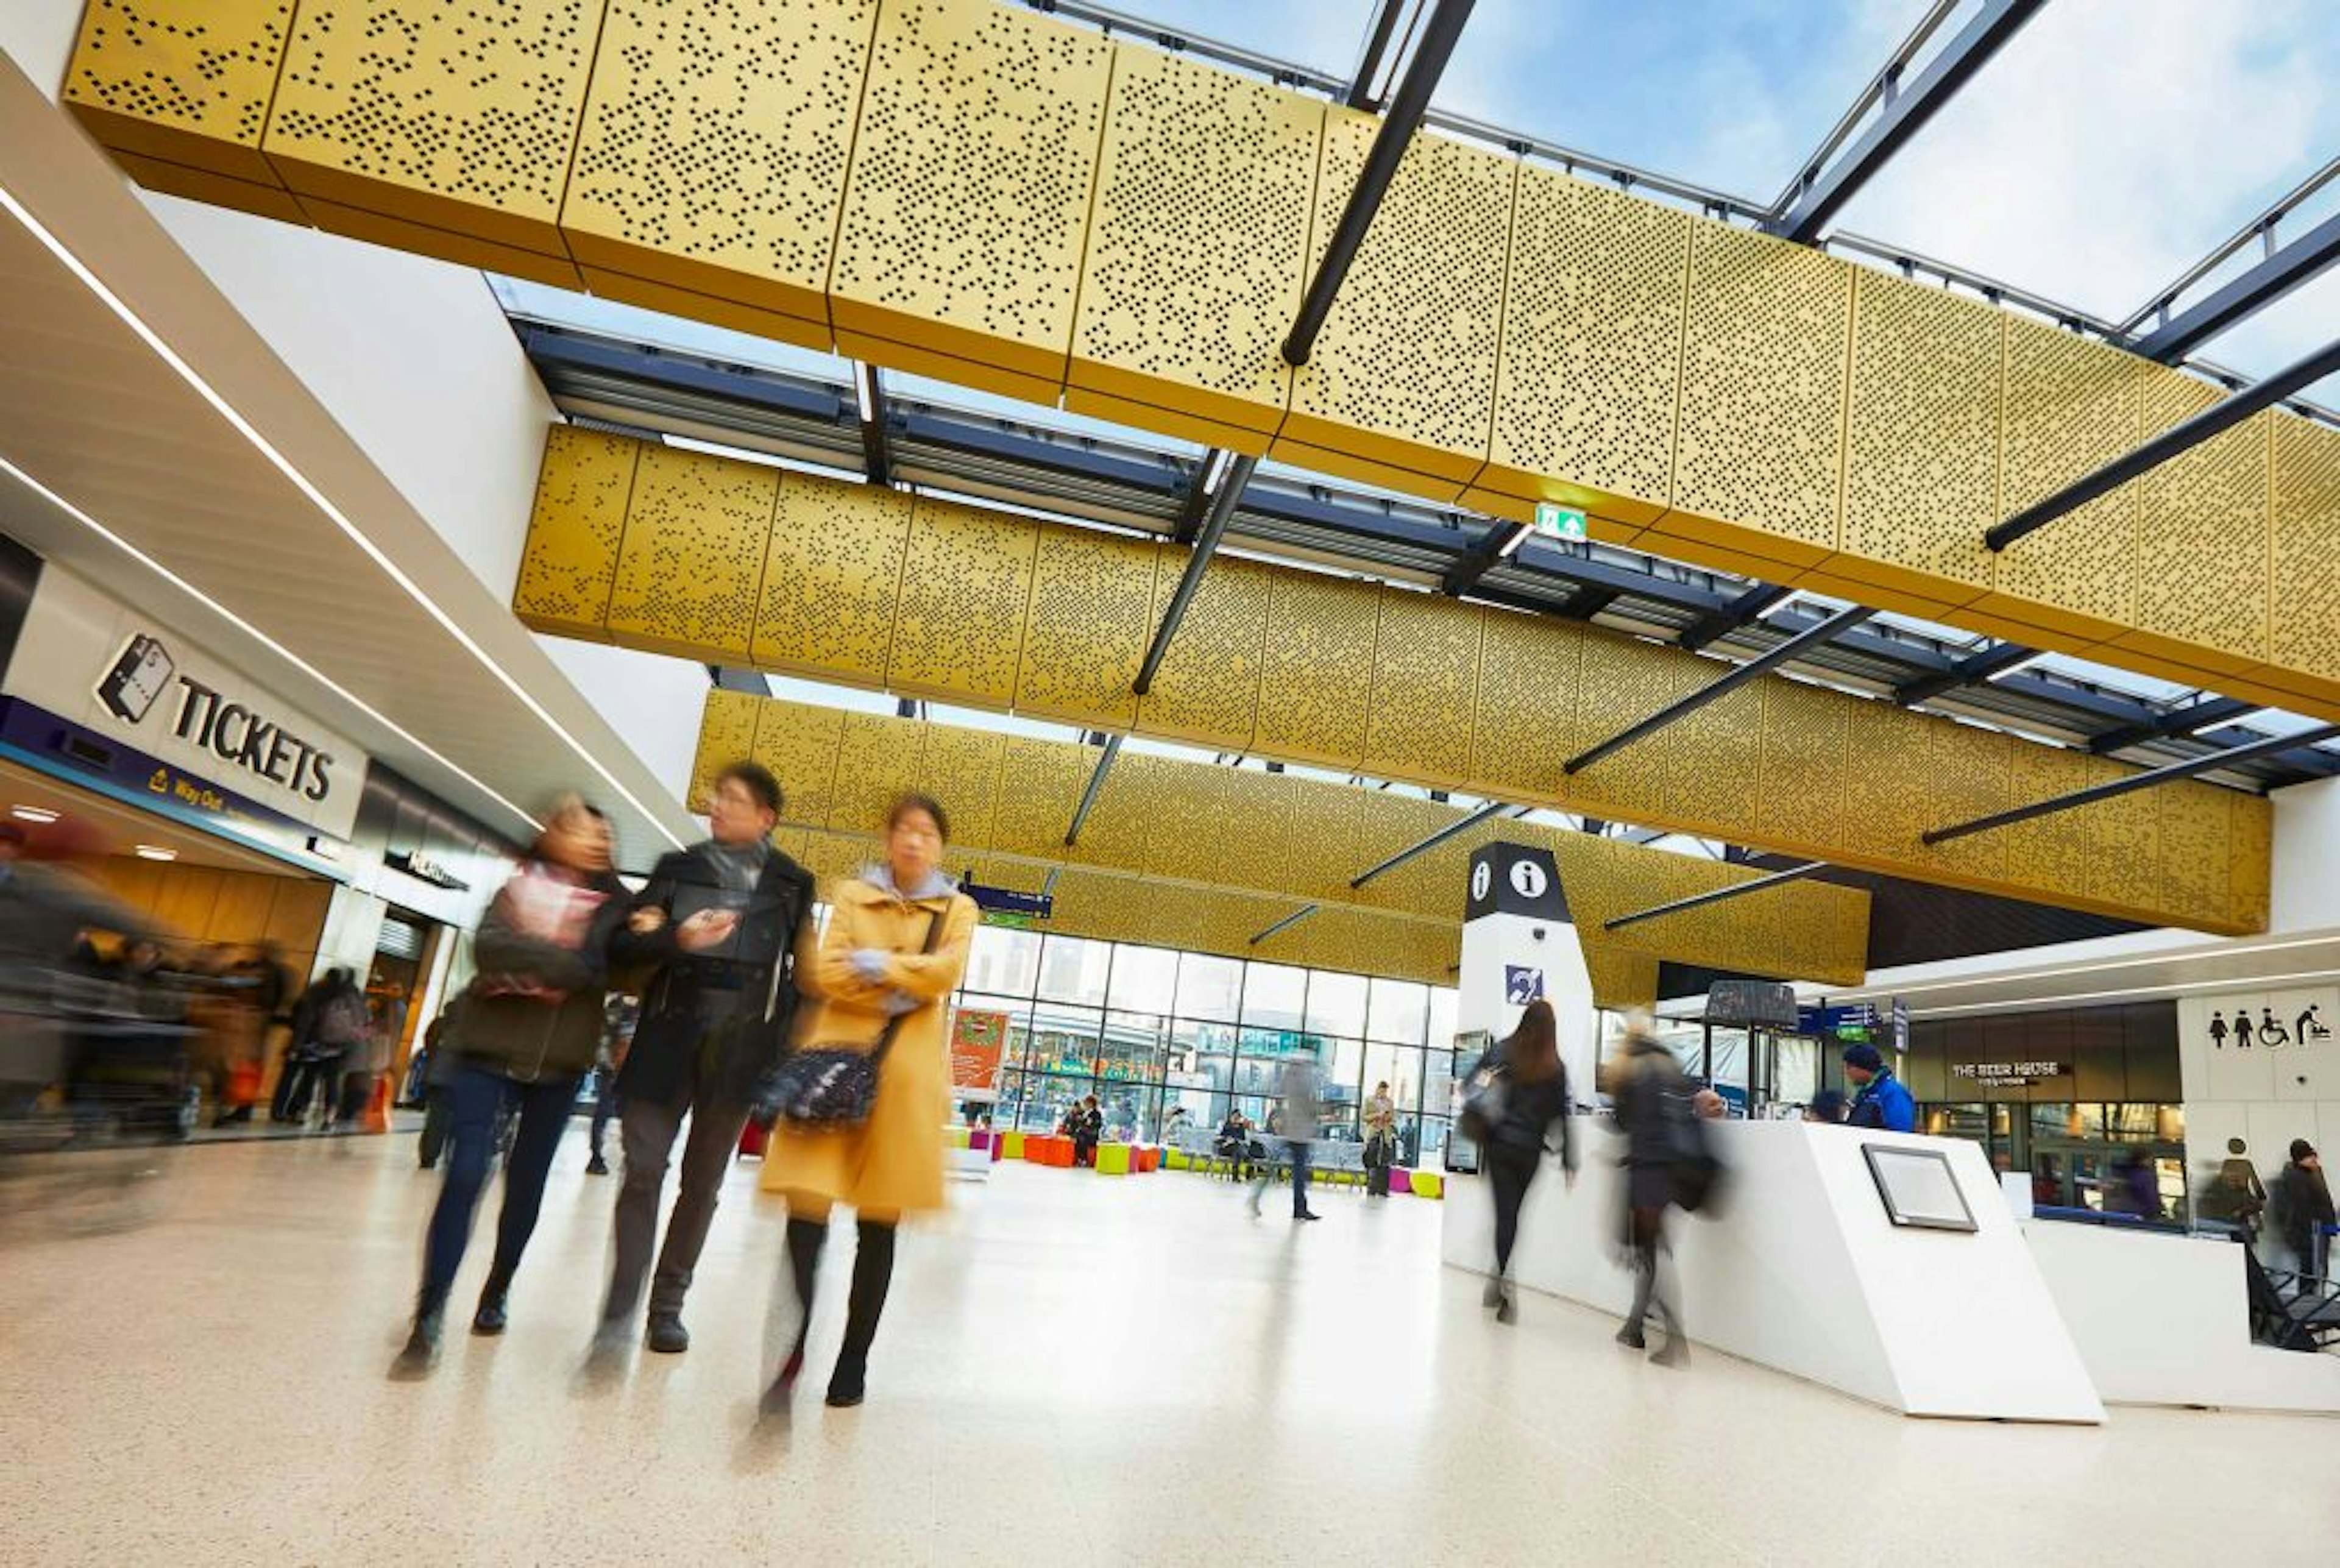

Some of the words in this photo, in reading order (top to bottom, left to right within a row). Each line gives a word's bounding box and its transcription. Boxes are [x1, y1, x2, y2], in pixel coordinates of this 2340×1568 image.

[177, 676, 333, 800] TICKETS
[175, 778, 200, 806] Way
[200, 790, 223, 811] Out
[1953, 1064, 1976, 1077] THE
[2015, 1062, 2058, 1076] HOUSE
